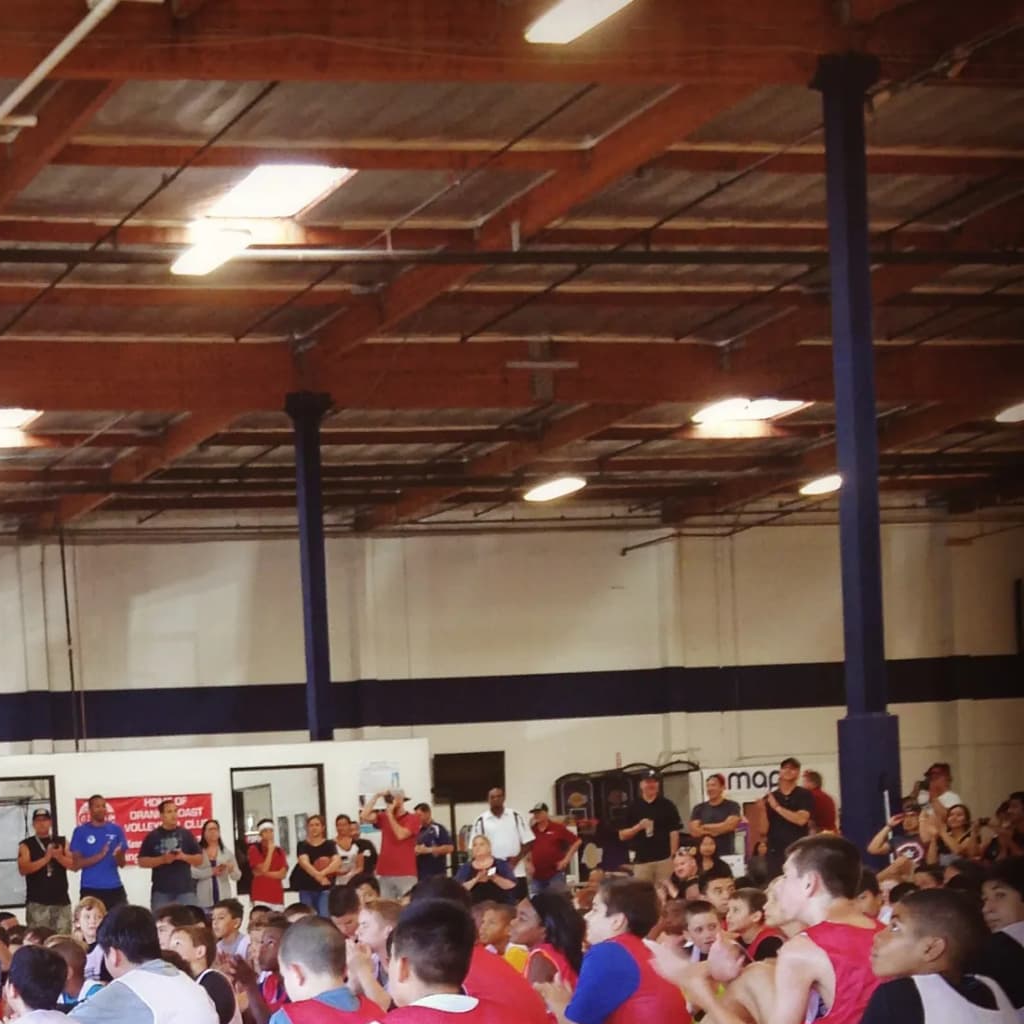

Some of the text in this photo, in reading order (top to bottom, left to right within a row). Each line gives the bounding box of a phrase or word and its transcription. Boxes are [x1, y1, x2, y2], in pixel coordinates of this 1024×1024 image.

[144, 796, 187, 807] HO OF
[129, 809, 160, 820] ORAN
[176, 807, 203, 818] OAST
